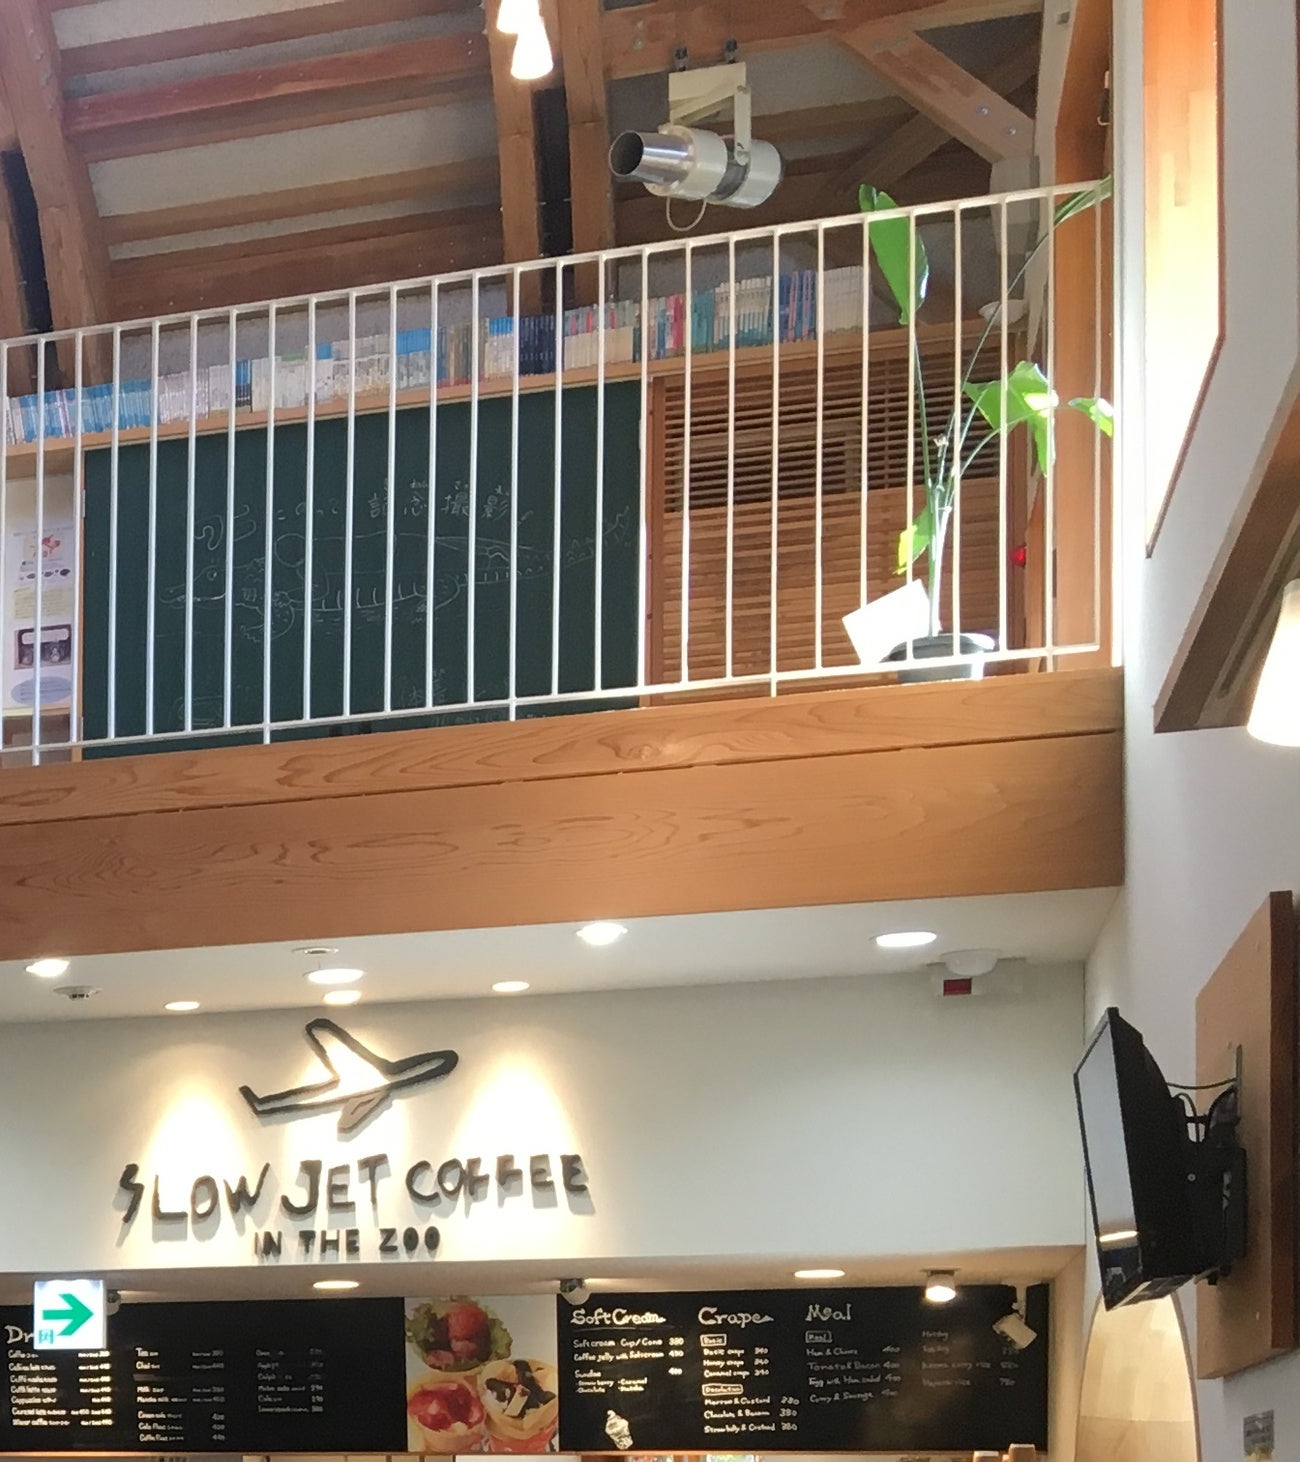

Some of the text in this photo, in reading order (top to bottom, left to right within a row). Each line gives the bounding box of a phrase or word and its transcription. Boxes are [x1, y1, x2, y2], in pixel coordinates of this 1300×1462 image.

[118, 1153, 588, 1225] SLOW JET COFFEE
[253, 1225, 441, 1258] IN THE ZOO
[570, 1307, 666, 1325] Soft Cream
[698, 1306, 774, 1329] Crape
[805, 1303, 852, 1321] Meal
